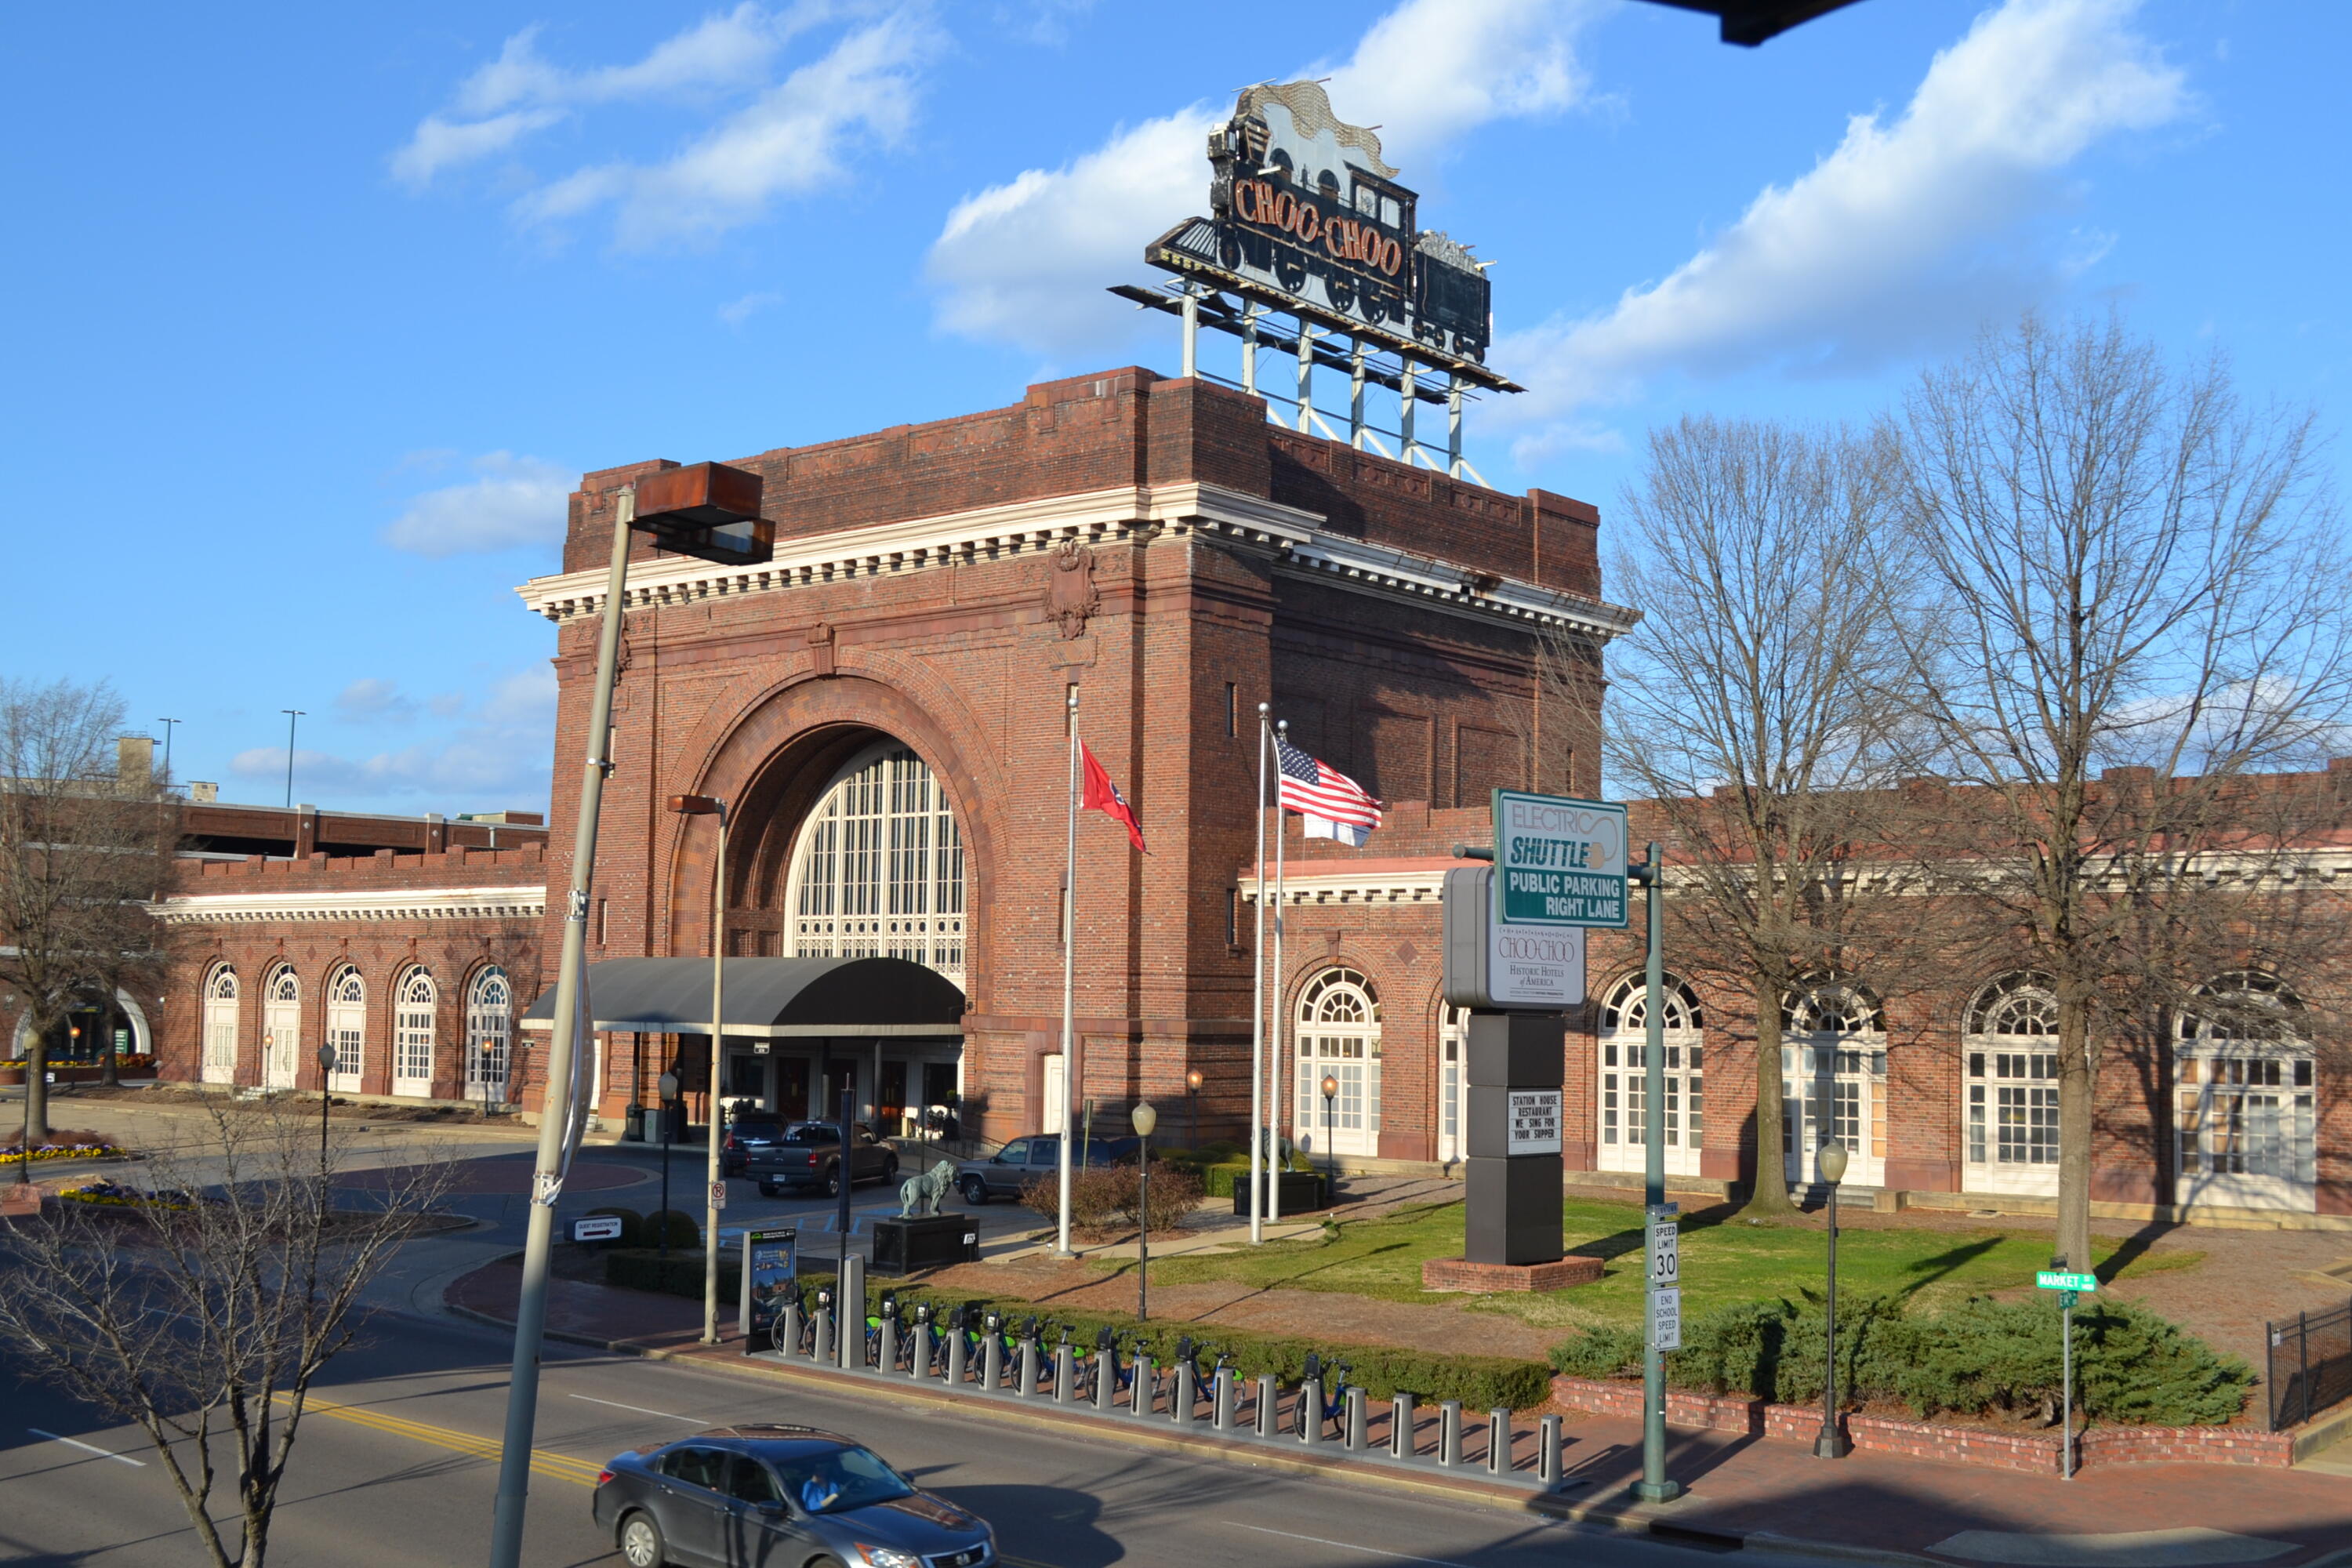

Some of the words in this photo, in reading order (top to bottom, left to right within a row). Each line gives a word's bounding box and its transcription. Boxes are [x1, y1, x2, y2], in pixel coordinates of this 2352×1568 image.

[1235, 178, 1402, 278] CHOO-CHOO
[1512, 804, 1594, 835] ELECTRIC
[1510, 836, 1590, 869] SHUTTLE
[1510, 872, 1560, 895] PUBLIC
[1563, 876, 1621, 898] PARKING
[1546, 896, 1584, 918] RIGHT
[1588, 900, 1621, 919] LANE
[1512, 1096, 1535, 1106] STATION
[1540, 1095, 1557, 1105] HOUSE
[1518, 1106, 1552, 1117] RESTAURANT
[1515, 1119, 1523, 1128] WE
[1529, 1118, 1541, 1127] SING
[1544, 1117, 1555, 1127] FOR
[1515, 1130, 1530, 1140] YOUR
[1534, 1129, 1555, 1139] SUPPER
[1656, 1226, 1676, 1237] SPEED
[1657, 1239, 1674, 1250] LIMIT
[1657, 1254, 1675, 1276] 30
[2038, 1273, 2079, 1288] MARKET
[1661, 1296, 1673, 1305] END
[1656, 1307, 1678, 1319] SCHOOL
[1657, 1319, 1676, 1330] SPEED
[1659, 1333, 1675, 1343] LIMIT
